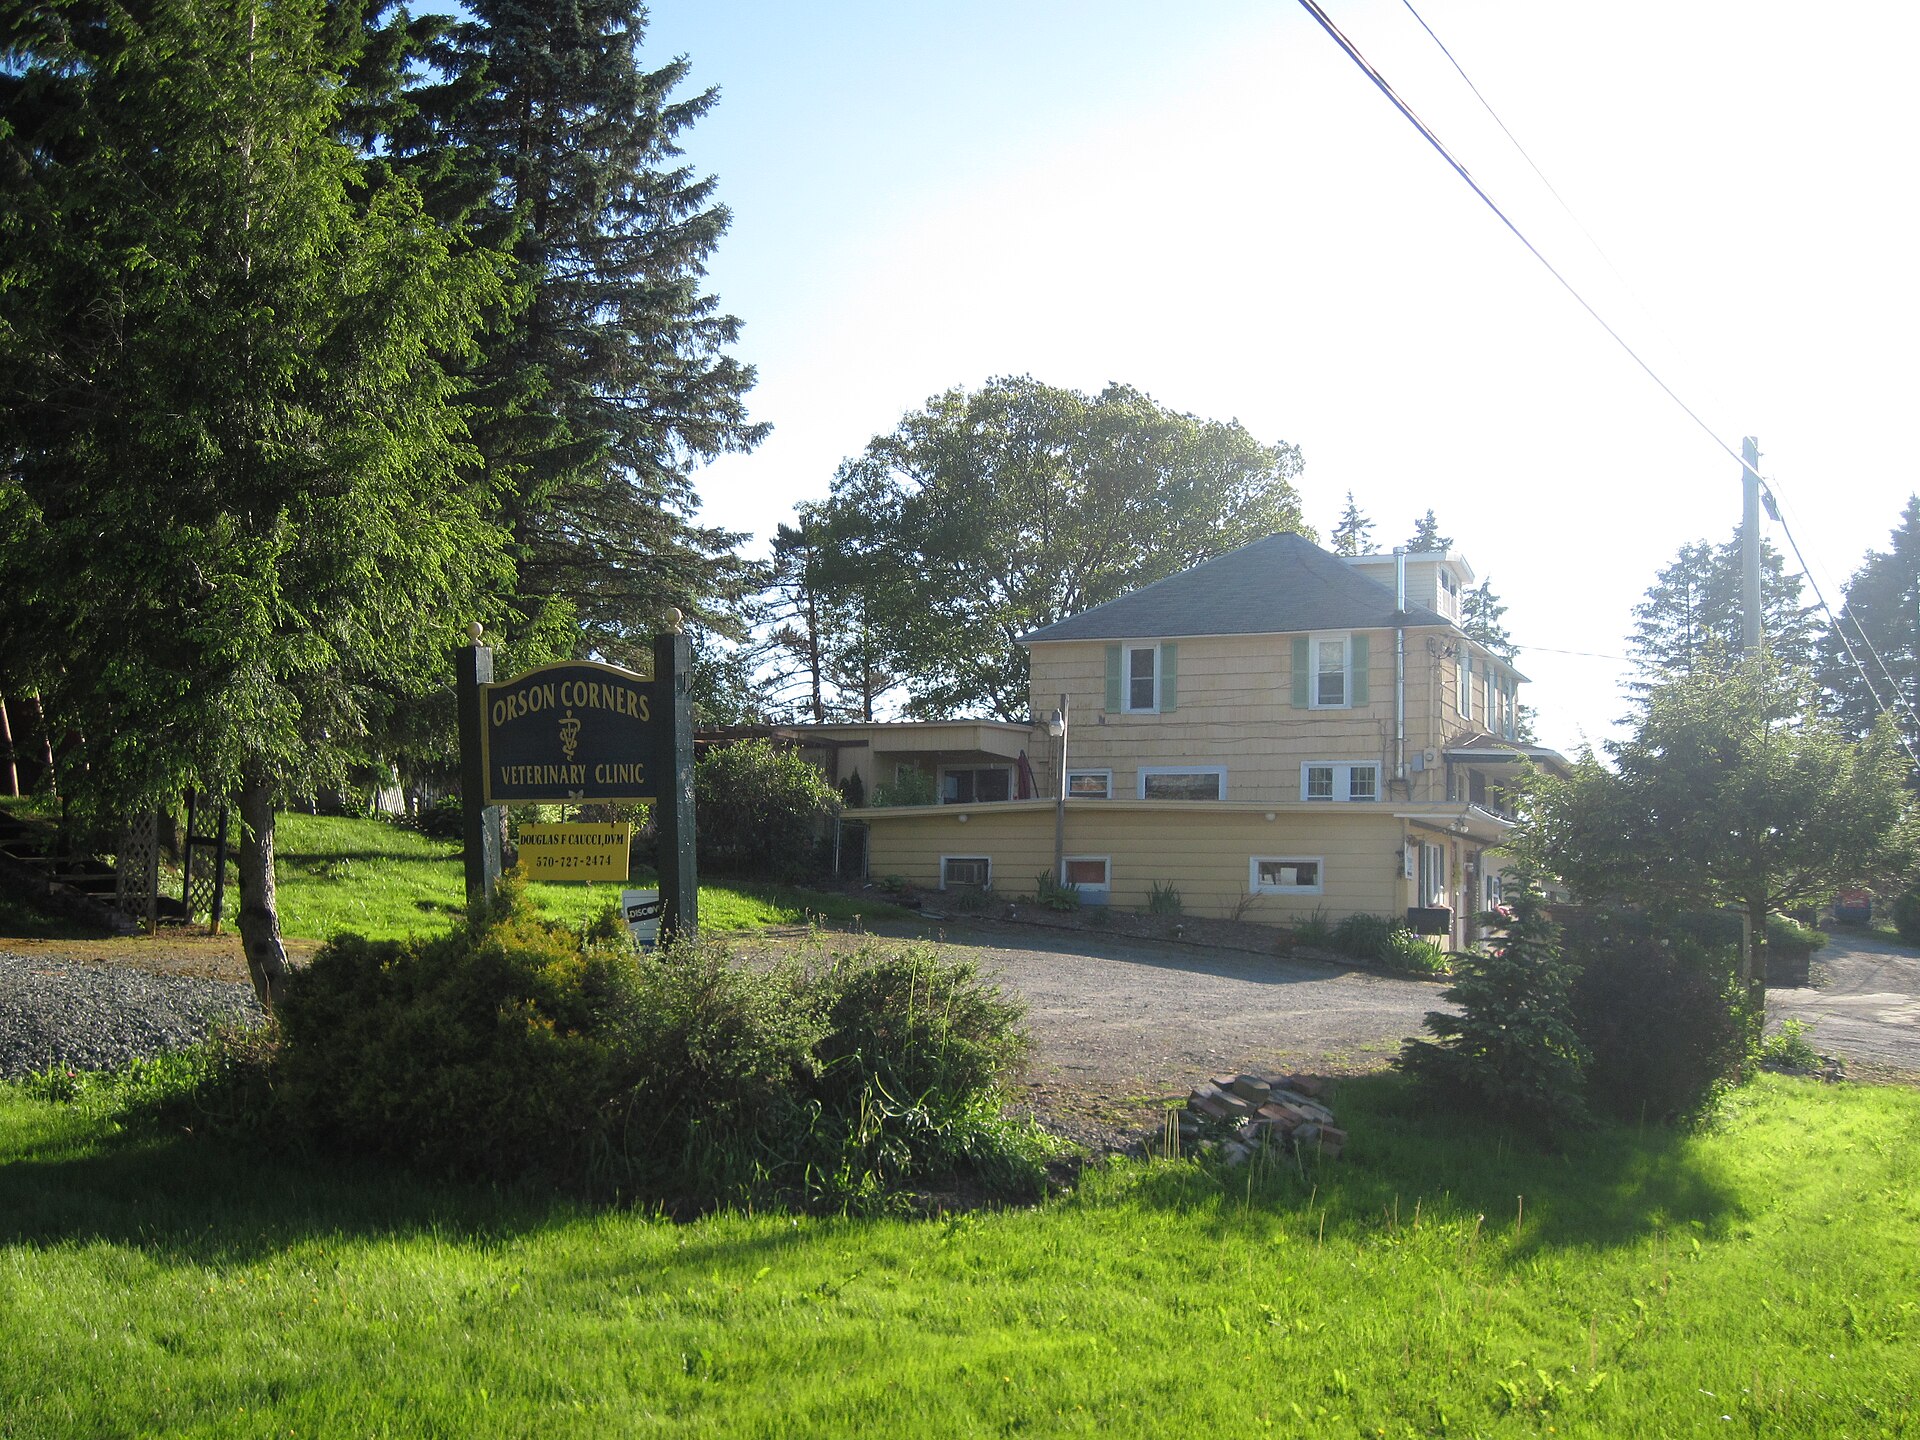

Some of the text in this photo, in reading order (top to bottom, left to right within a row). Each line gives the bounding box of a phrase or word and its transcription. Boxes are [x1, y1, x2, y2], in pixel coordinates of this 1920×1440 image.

[492, 681, 650, 727] ORSON CORNERS
[501, 763, 646, 785] VETERINARY CLINIC
[520, 834, 560, 846] DOUGLAS
[561, 834, 567, 845] F
[536, 855, 611, 867] 570-727-2474
